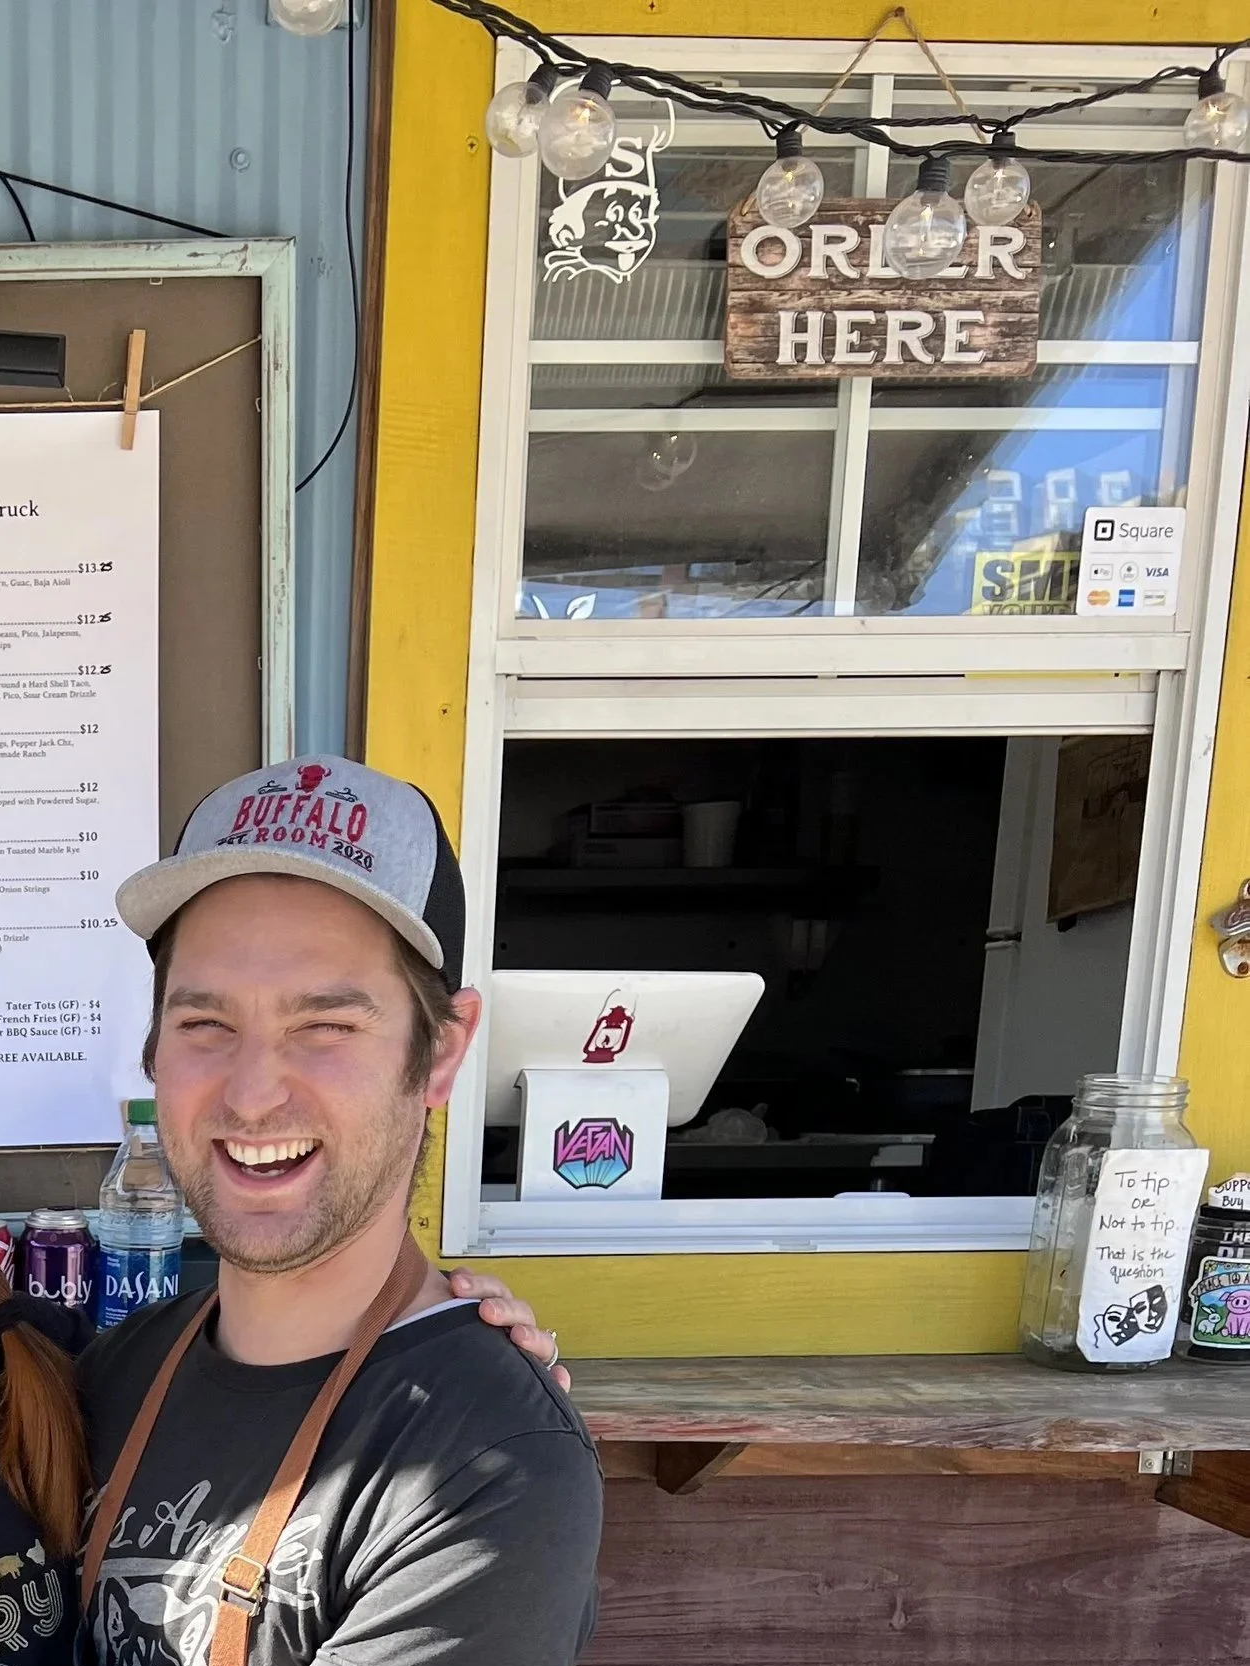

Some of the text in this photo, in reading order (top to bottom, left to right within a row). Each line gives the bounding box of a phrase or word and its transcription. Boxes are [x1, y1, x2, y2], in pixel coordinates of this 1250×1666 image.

[740, 224, 1033, 280] ORR
[776, 310, 987, 366] HERE
[1118, 523, 1174, 541] Square
[1145, 567, 1170, 577] VISA
[80, 724, 99, 735] $12
[80, 782, 99, 793] $12
[231, 793, 368, 843] BUFFALO
[78, 832, 98, 842] $10
[253, 826, 330, 850] ROOM
[332, 840, 374, 869] 2020
[80, 870, 99, 881] $10
[5, 1001, 33, 1011] Tater
[33, 1000, 56, 1010] Tots
[58, 999, 80, 1011] (GF)
[88, 999, 101, 1009] $4
[33, 1013, 58, 1023] Fries
[59, 1013, 81, 1024] (GF)
[89, 1012, 102, 1023] $4
[6, 1027, 28, 1038] BBQ
[29, 1027, 59, 1037] Sauce
[60, 1026, 82, 1037] (GF)
[90, 1025, 101, 1035] $1
[556, 1121, 630, 1167] VEGAN
[1115, 1170, 1137, 1189] To
[1099, 1215, 1125, 1231] Not
[1130, 1215, 1146, 1231] to
[1096, 1245, 1176, 1261] That is the
[1110, 1264, 1165, 1285] question
[29, 1273, 92, 1304] bubly
[106, 1271, 179, 1305] DASANI
[138, 1479, 323, 1598] Angles
